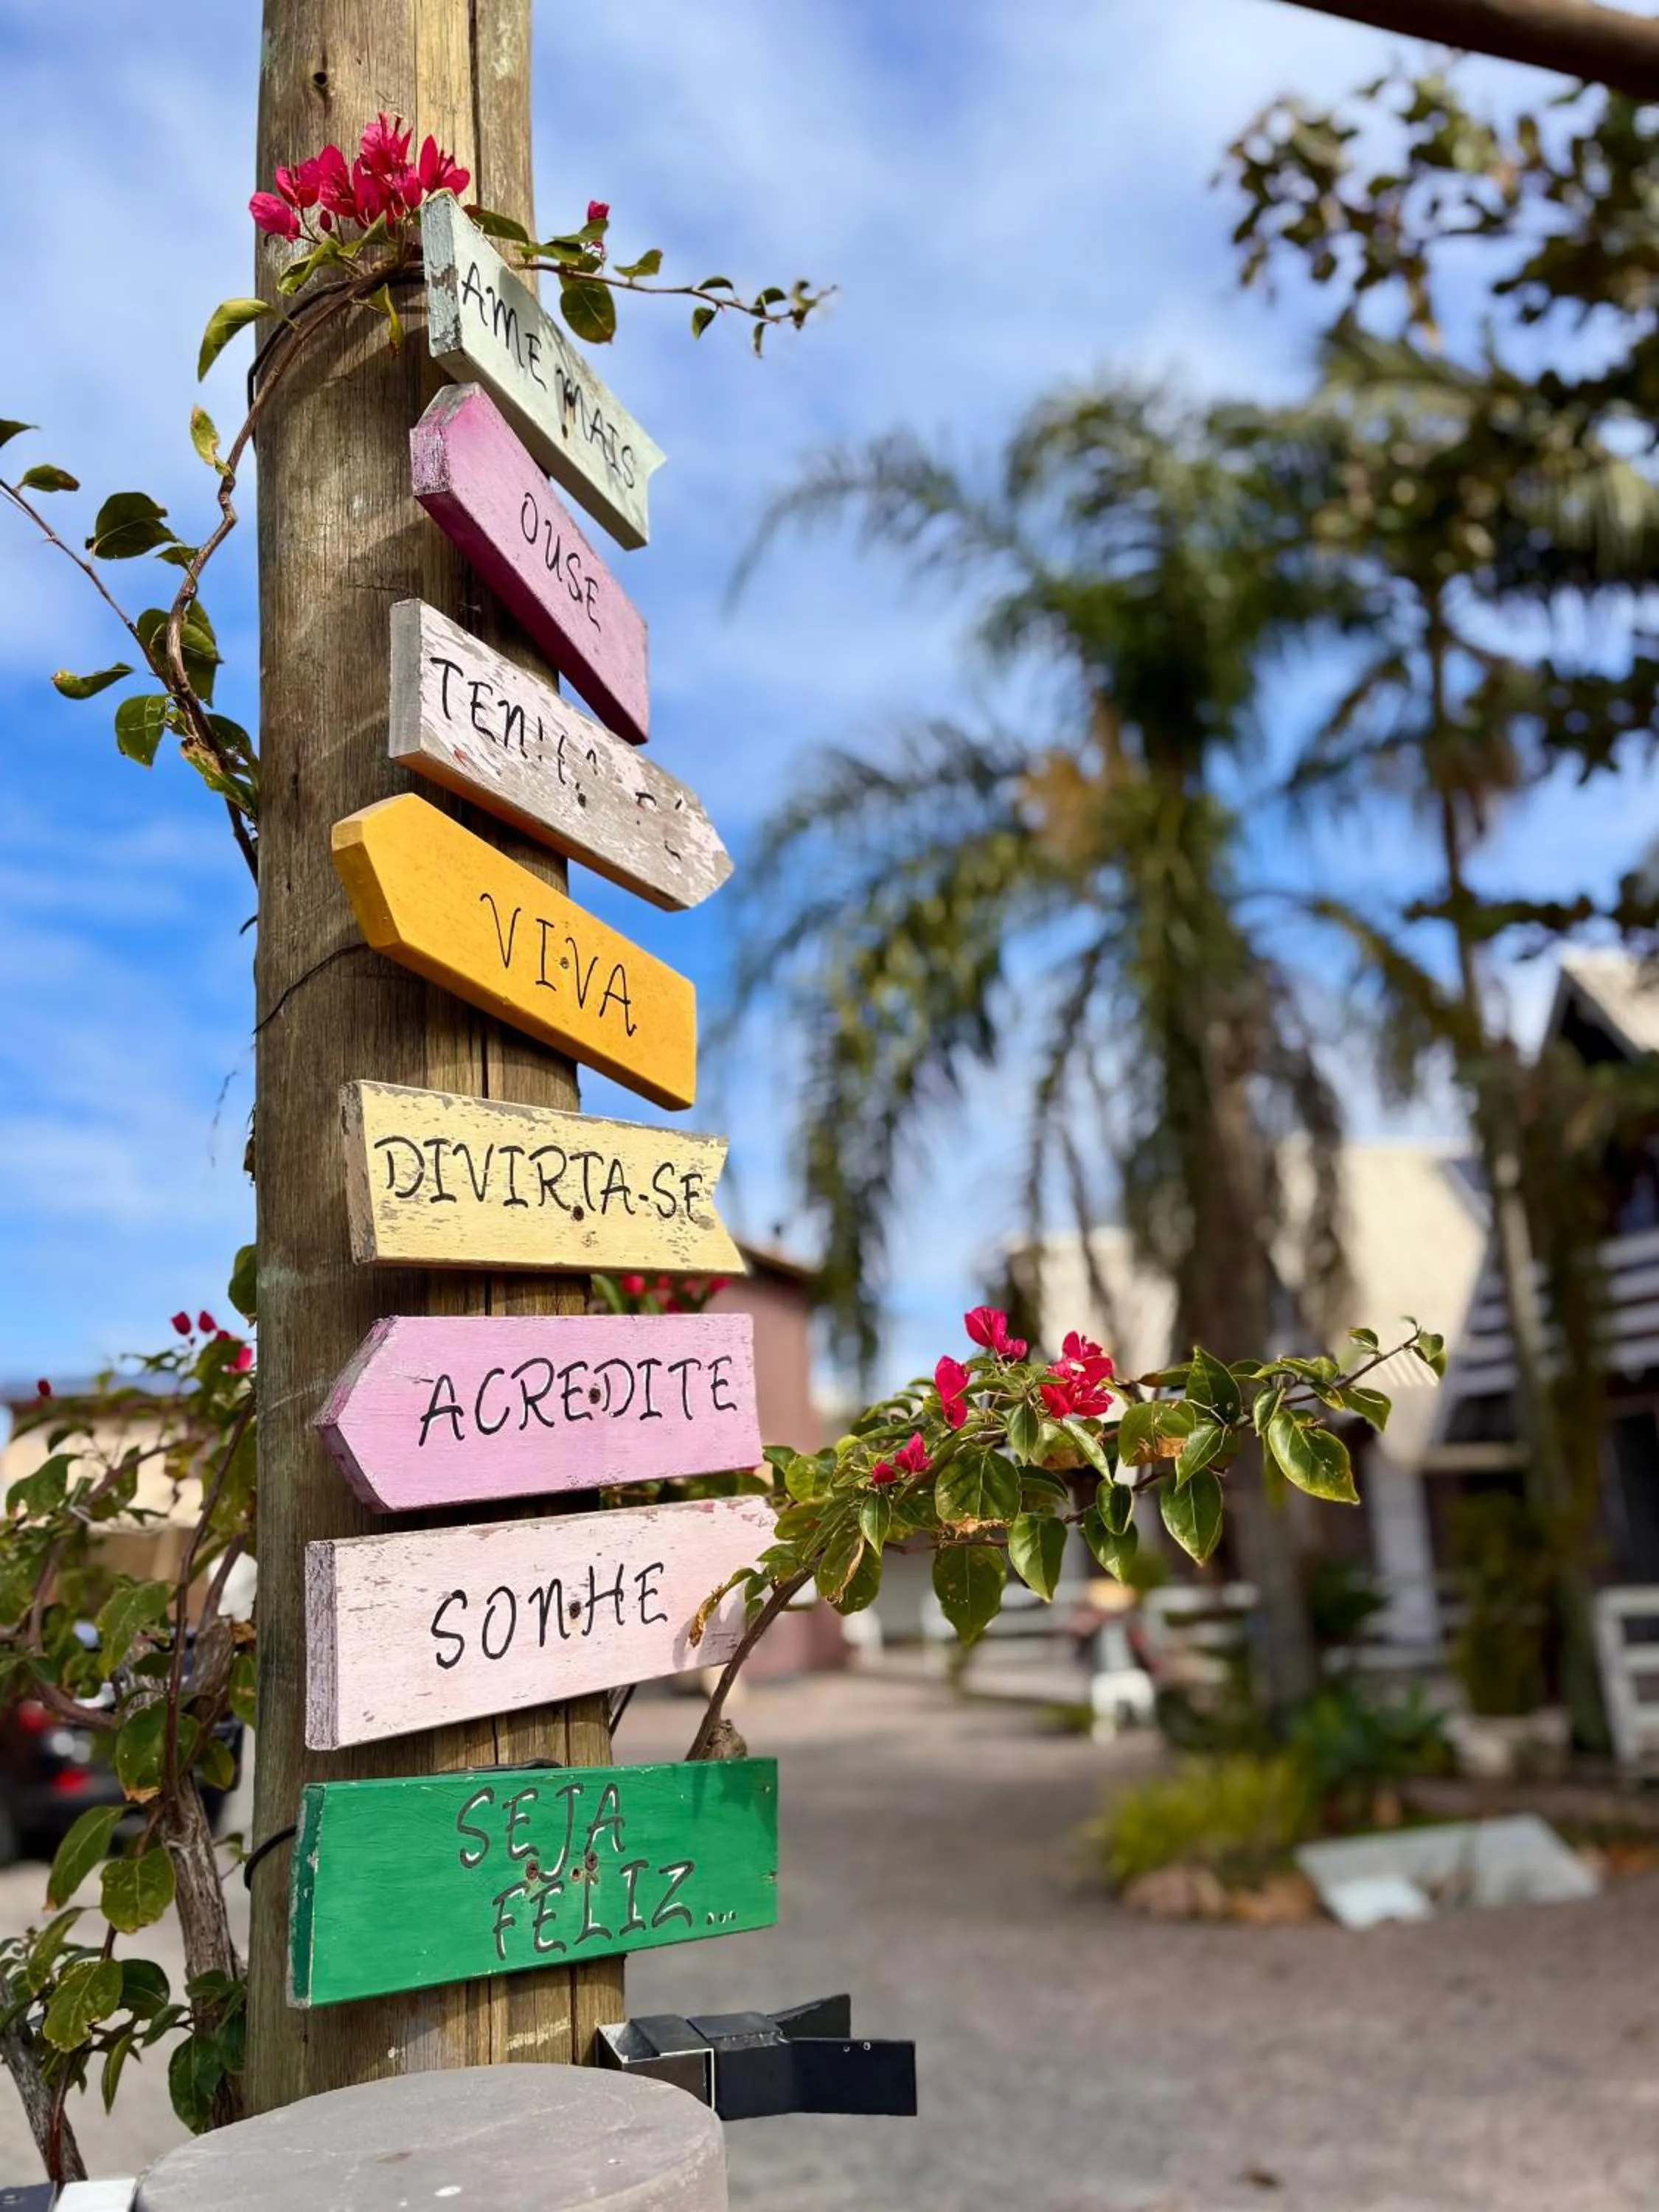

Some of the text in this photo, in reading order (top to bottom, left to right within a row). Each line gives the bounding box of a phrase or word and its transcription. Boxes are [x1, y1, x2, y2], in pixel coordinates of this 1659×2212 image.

[461, 261, 635, 490] AME MAIS
[520, 492, 602, 633] OUSE
[479, 892, 638, 1037] VIVA
[373, 1135, 703, 1225] DIVIRTA-SE
[418, 1355, 738, 1447] ACREDITE
[430, 1561, 668, 1670] SONHE
[456, 1781, 626, 1883] SEJA
